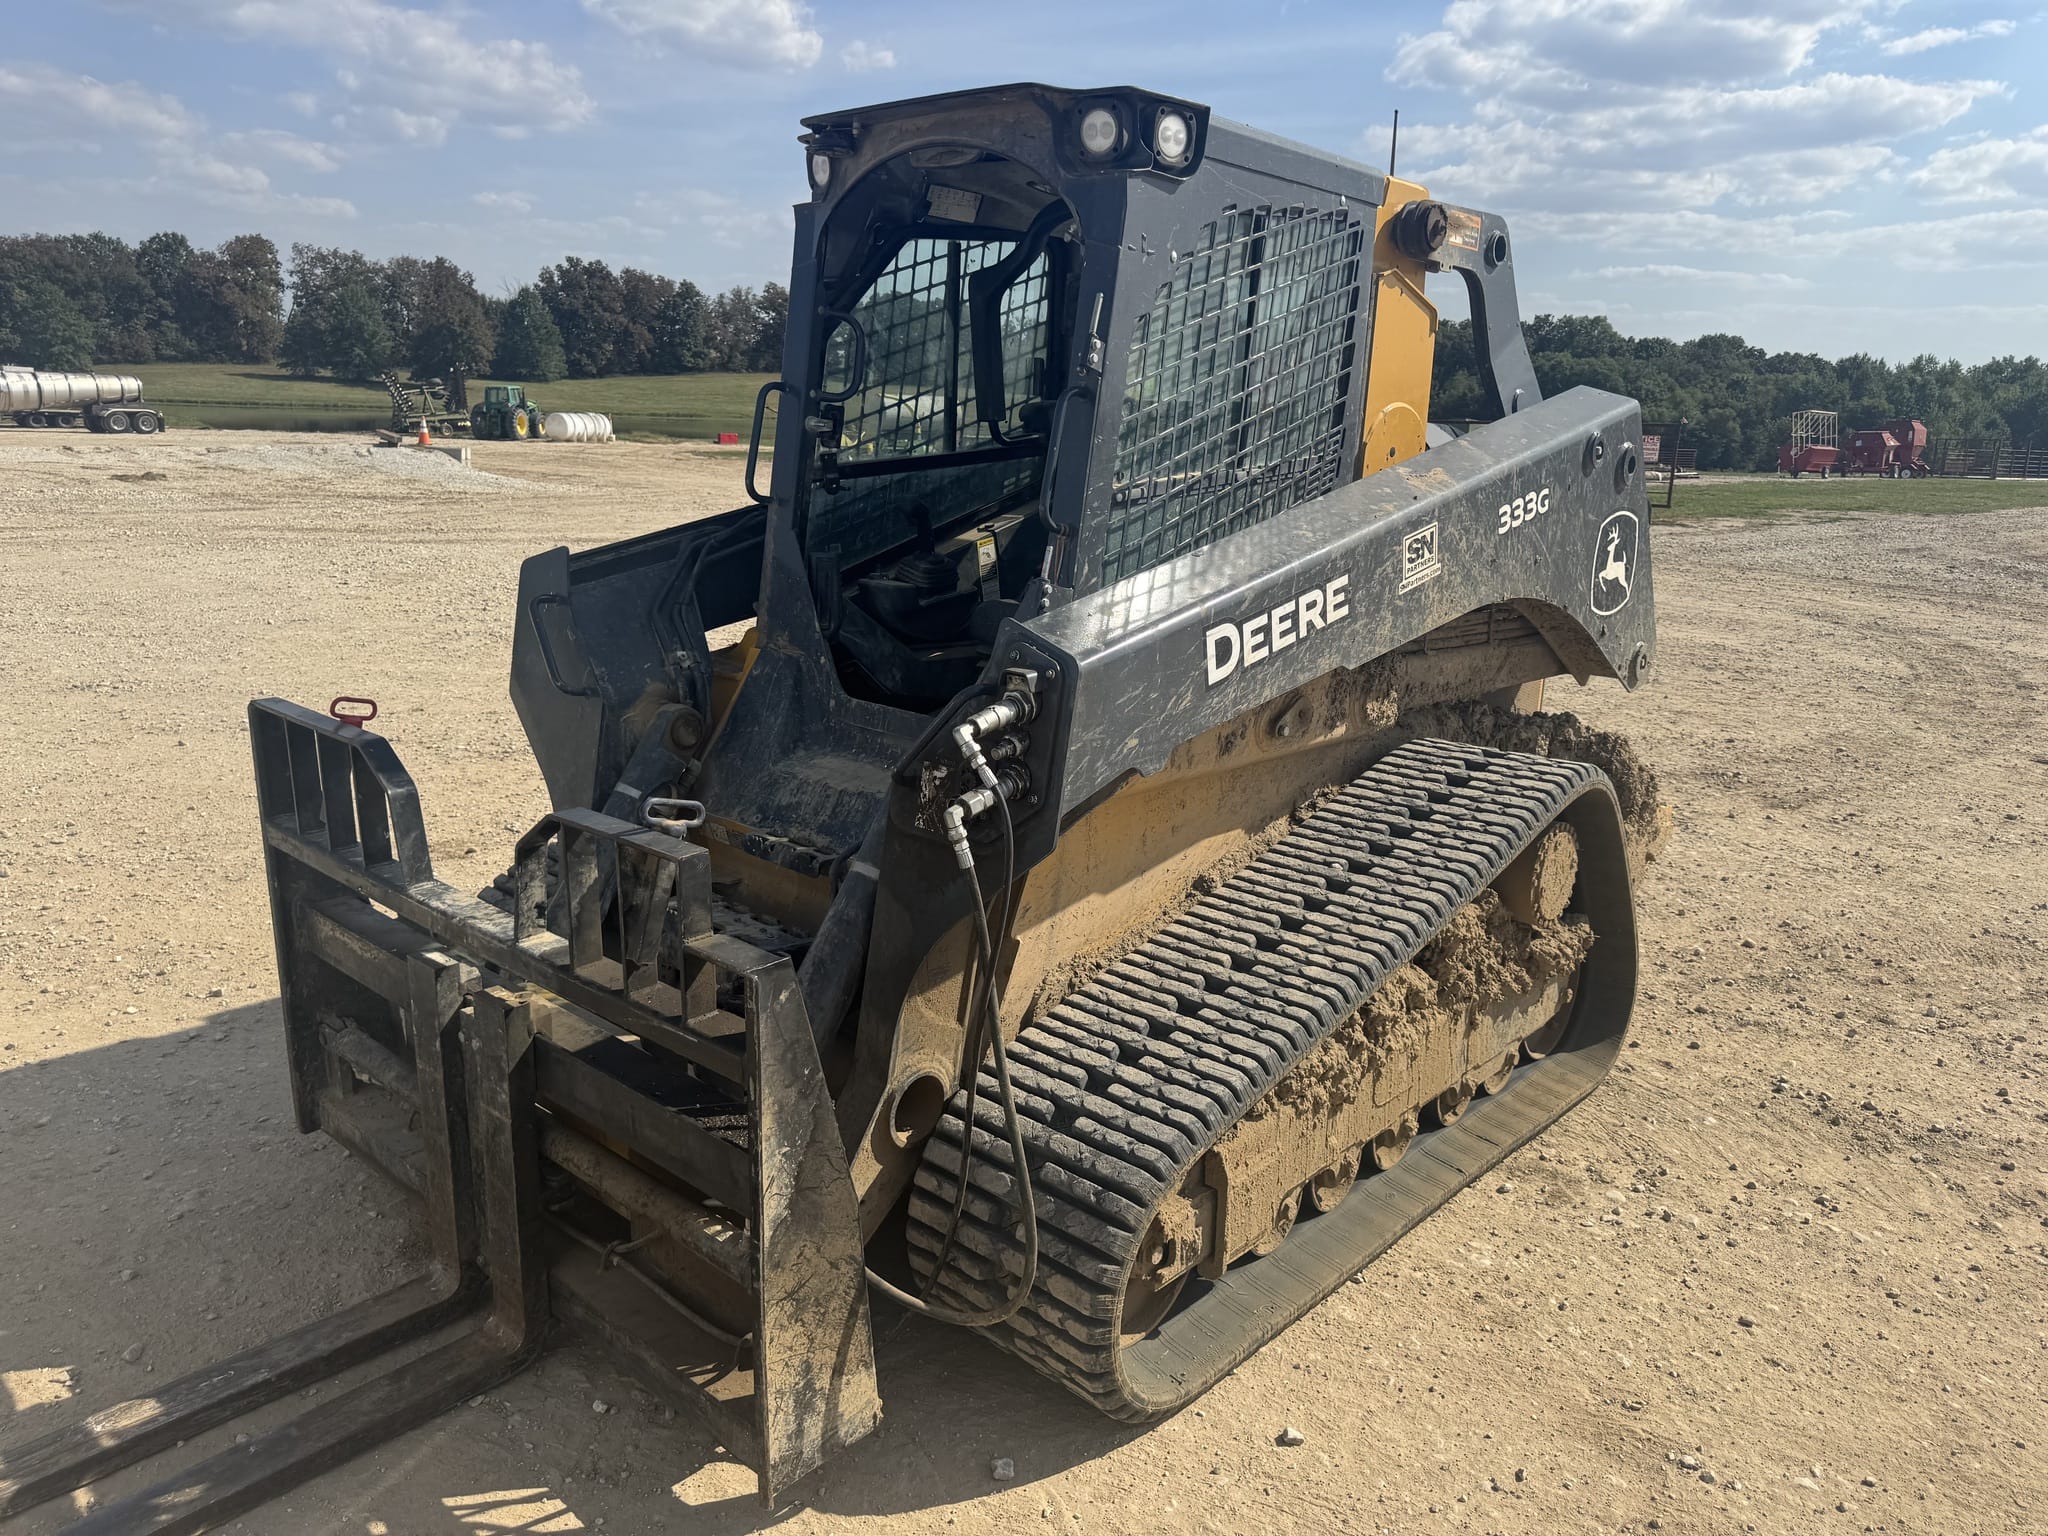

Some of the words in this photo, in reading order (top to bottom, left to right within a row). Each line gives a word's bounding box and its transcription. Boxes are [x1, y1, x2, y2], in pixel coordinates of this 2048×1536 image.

[1498, 488, 1550, 535] 333G
[1406, 556, 1435, 575] PARTNERS
[1407, 531, 1435, 564] SN
[1206, 574, 1349, 686] DEERE
